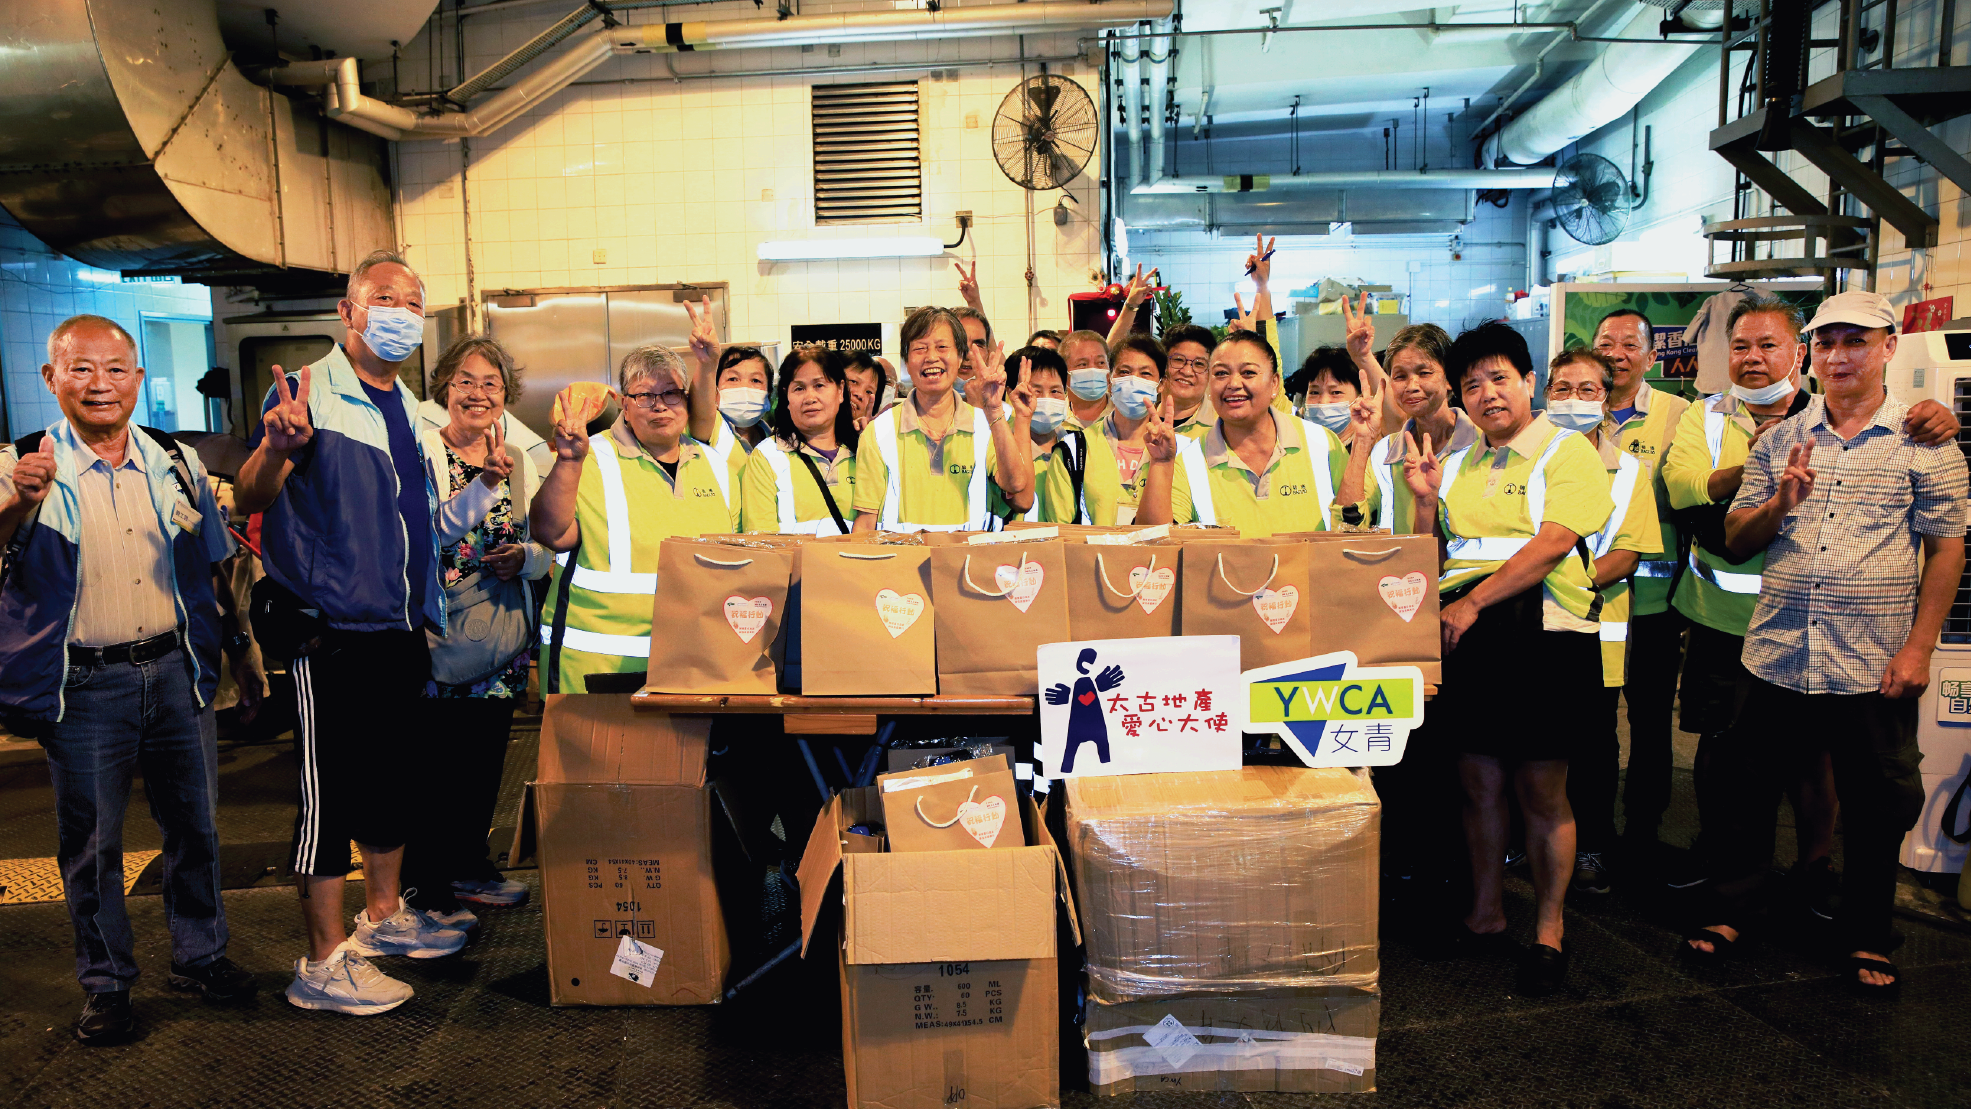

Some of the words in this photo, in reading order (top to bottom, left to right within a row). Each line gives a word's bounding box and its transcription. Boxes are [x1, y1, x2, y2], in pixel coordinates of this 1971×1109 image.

[1106, 688, 1213, 714] 太古地產
[1273, 683, 1394, 718] YWCA
[1949, 697, 1971, 714] 自
[1121, 711, 1229, 738] 愛心大使
[1330, 723, 1394, 754] 女青
[616, 901, 641, 912] 1054
[939, 963, 969, 977] 1054
[957, 982, 971, 990] 600
[988, 980, 1002, 988] ML
[960, 991, 971, 999] 60
[985, 989, 1003, 998] PCS
[956, 1001, 967, 1009] 8.5
[989, 998, 1002, 1006] KG
[956, 1009, 967, 1017] 7.5
[989, 1006, 1002, 1015] KG
[988, 1016, 1003, 1024] CM
